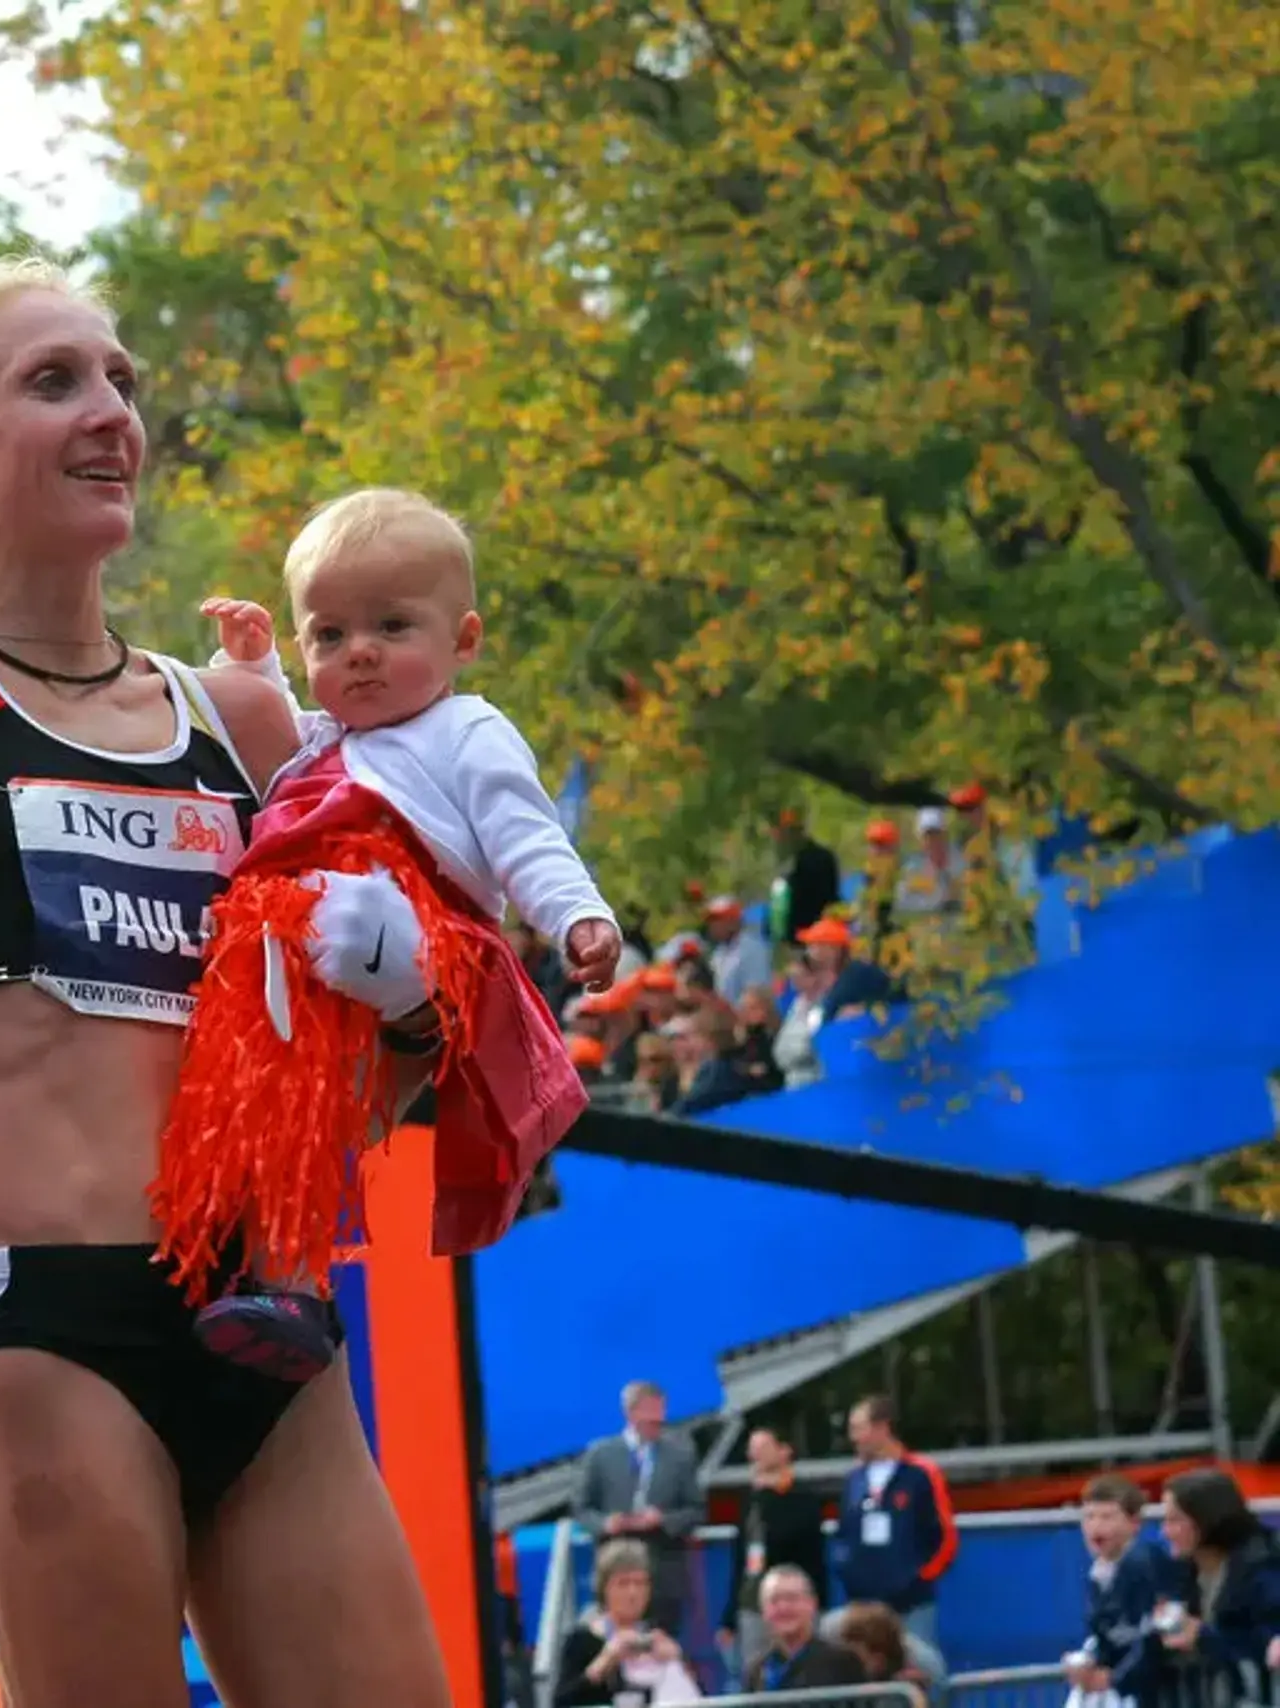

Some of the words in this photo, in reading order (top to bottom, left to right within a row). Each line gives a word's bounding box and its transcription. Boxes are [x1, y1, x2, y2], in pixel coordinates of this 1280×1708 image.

[57, 800, 158, 849] ING
[68, 982, 106, 1001] NEW
[108, 986, 143, 1007] YORK
[144, 992, 174, 1011] CITY
